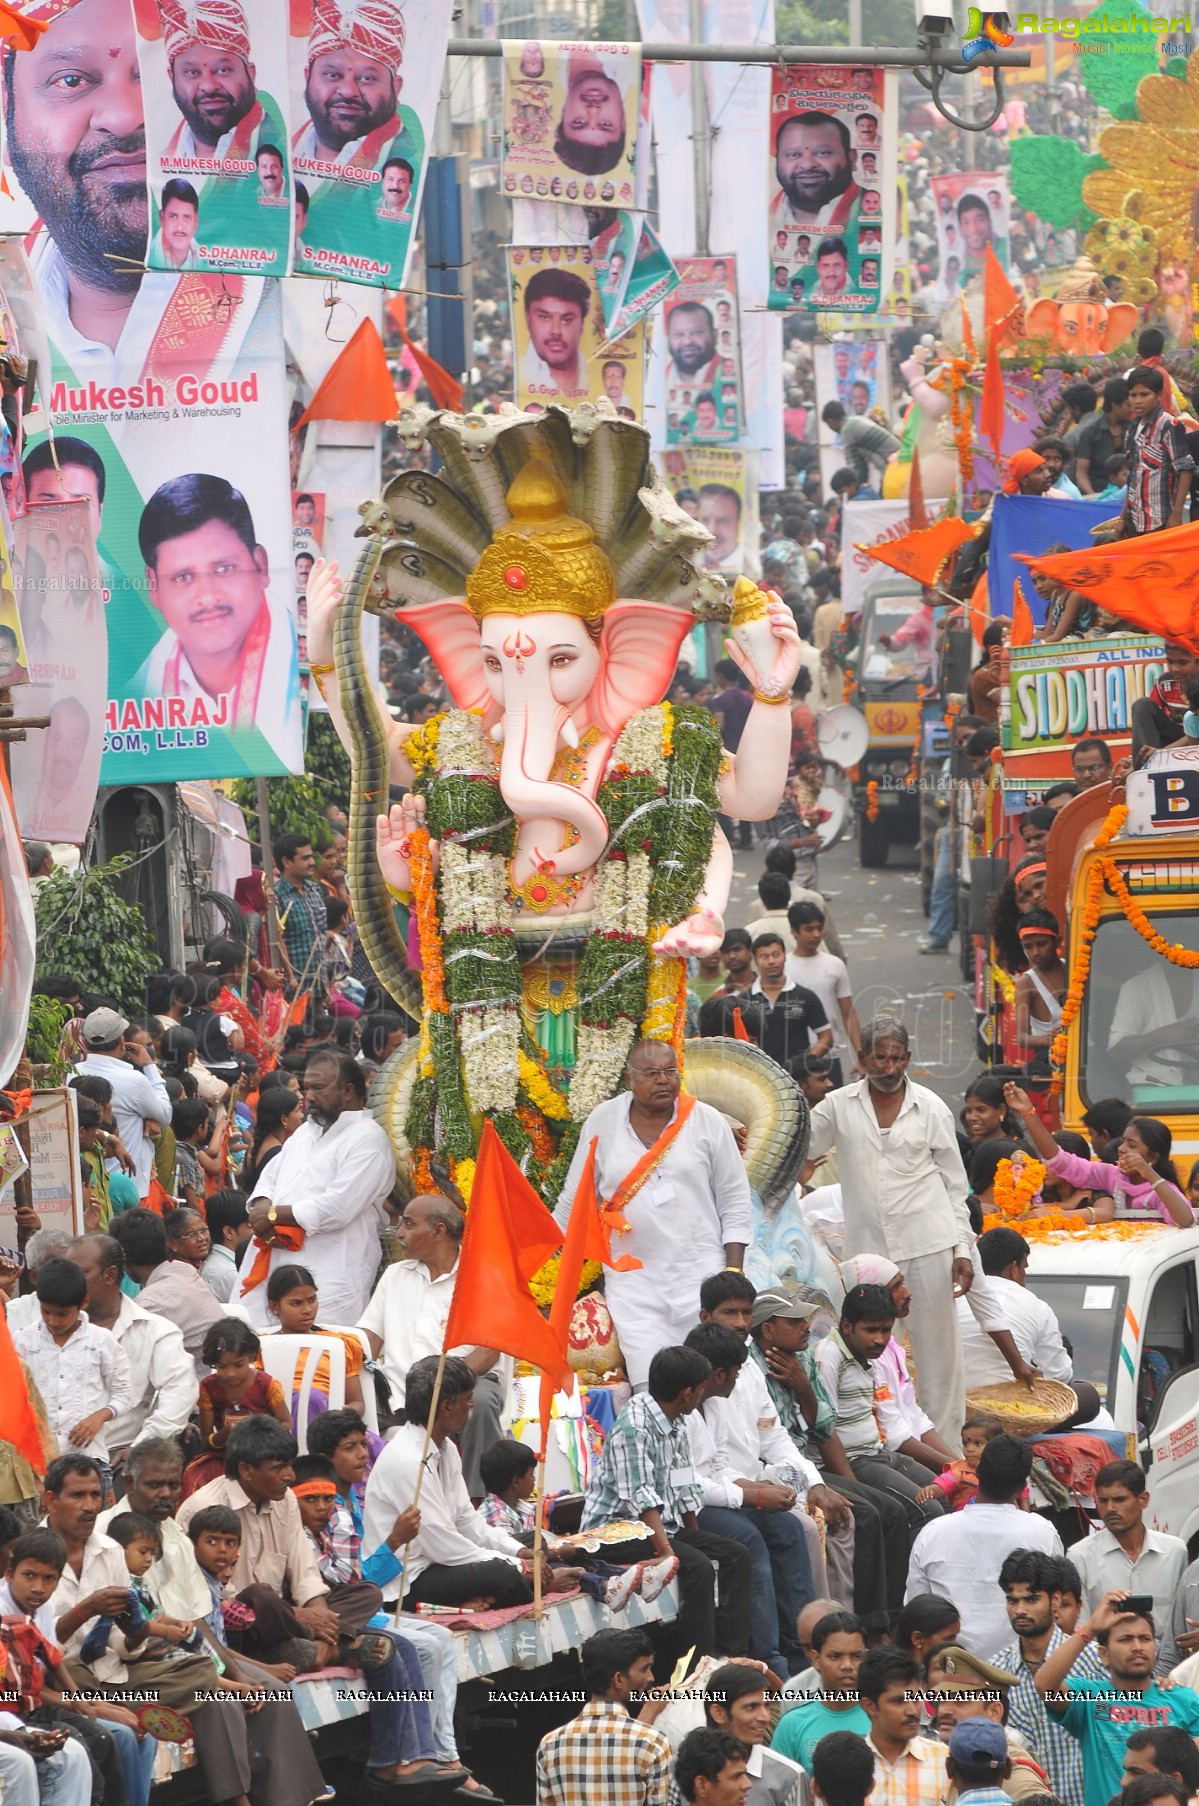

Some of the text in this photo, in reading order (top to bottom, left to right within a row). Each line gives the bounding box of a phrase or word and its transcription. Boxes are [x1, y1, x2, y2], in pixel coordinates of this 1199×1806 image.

[160, 157, 255, 172] M.MUKESH GOUD
[345, 166, 380, 182] GOUD
[199, 247, 275, 262] S.DHANRAJ
[304, 247, 390, 275] S.DHANRAJ
[176, 373, 258, 405] Goud
[528, 384, 560, 398] G.Gopi
[72, 411, 108, 424] Minister
[110, 410, 122, 422] for
[125, 408, 170, 421] Marketing
[172, 408, 179, 418] &
[182, 406, 241, 418] Warehousing
[1097, 646, 1166, 663] ALL IND
[157, 730, 208, 749] L.L.B
